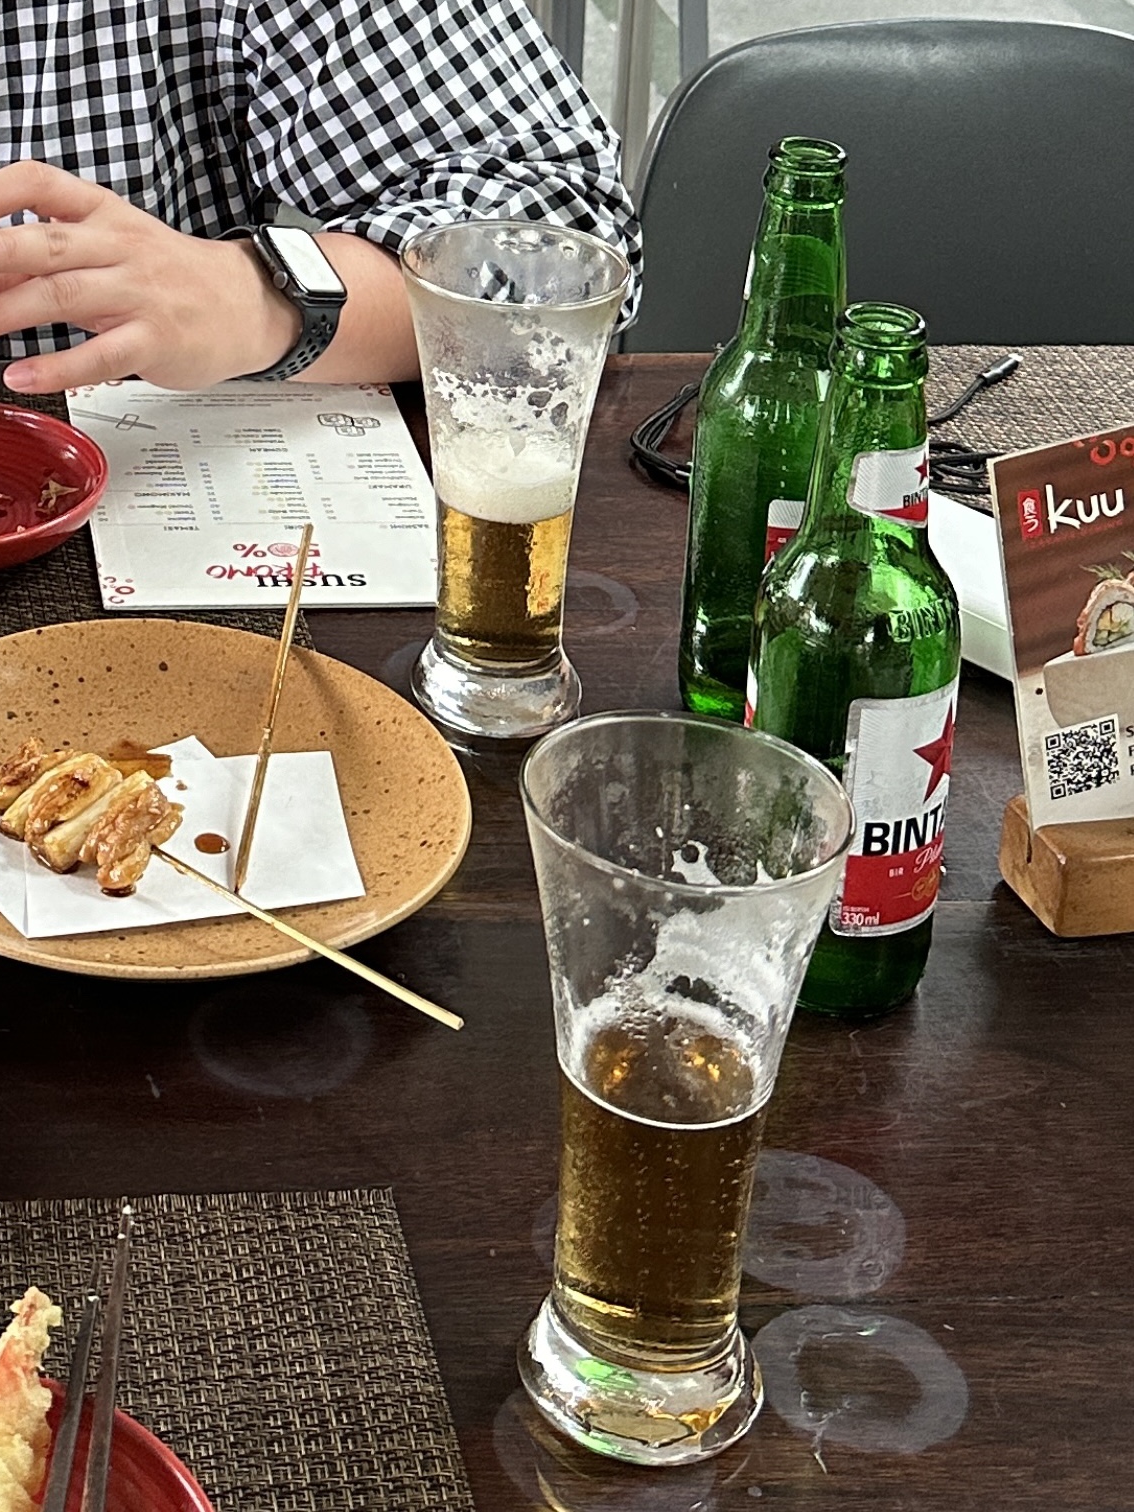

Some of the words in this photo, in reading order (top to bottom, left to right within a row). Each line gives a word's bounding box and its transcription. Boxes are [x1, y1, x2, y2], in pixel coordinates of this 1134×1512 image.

[1045, 484, 1125, 534] kuu
[206, 562, 324, 580] PROMO
[256, 573, 367, 587] SUSHI
